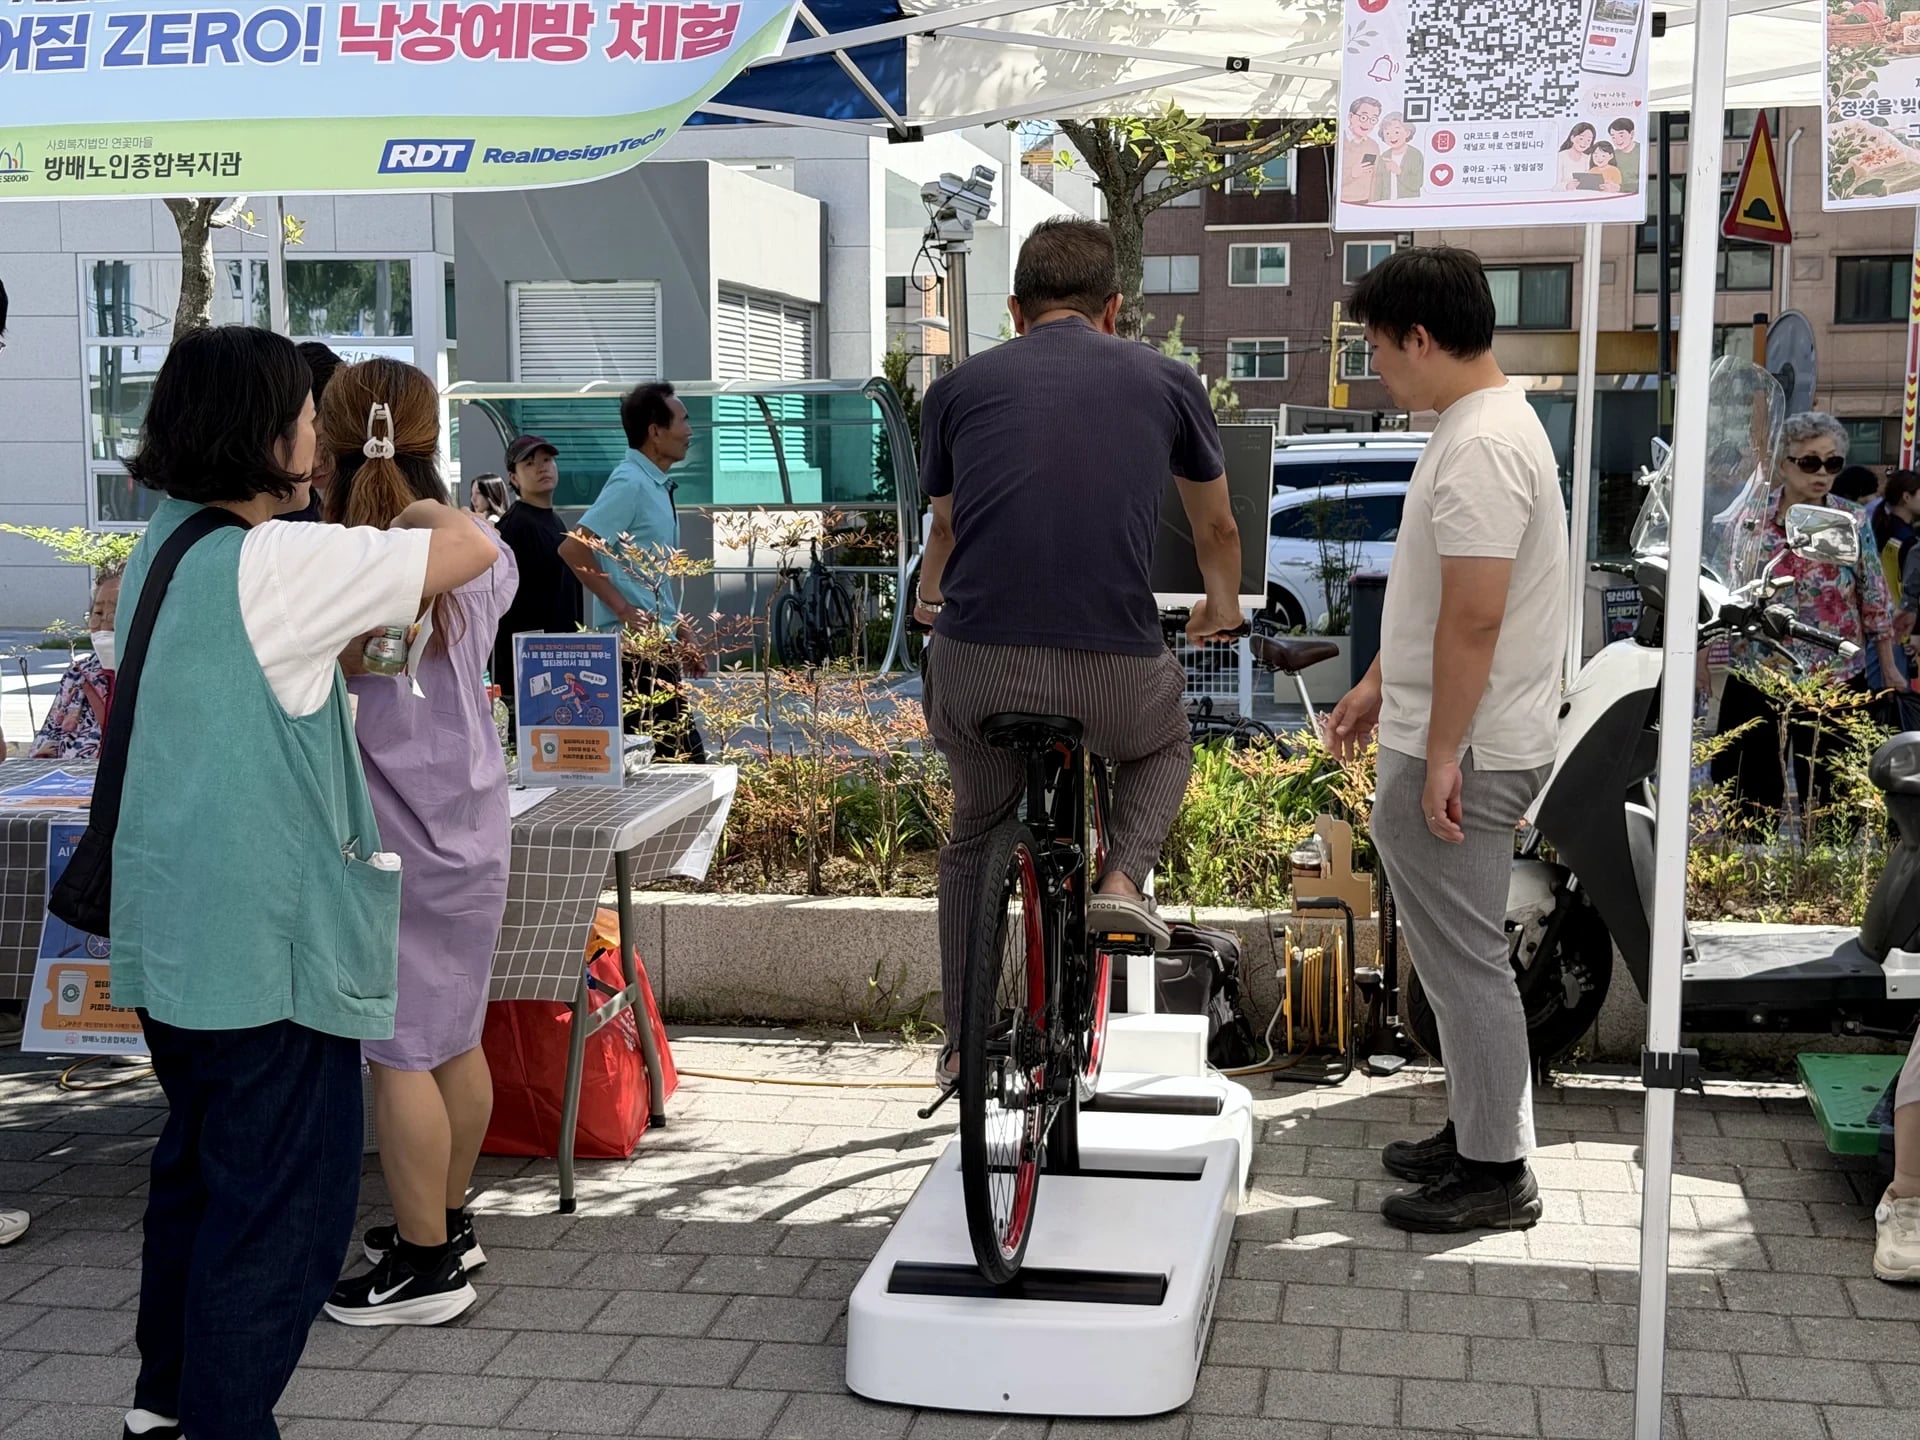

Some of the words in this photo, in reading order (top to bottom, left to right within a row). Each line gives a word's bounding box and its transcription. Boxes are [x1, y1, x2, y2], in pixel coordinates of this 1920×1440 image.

[103, 6, 323, 67] ZERO!
[338, 2, 596, 63] 낙상예방
[605, 1, 743, 62] 체험
[1463, 131, 1500, 141] QR코드를
[1502, 130, 1534, 139] 스캔하면
[46, 138, 109, 151] 사회복지법인
[111, 136, 154, 149] 연꽃마을
[387, 144, 466, 168] RDT
[483, 127, 667, 164] RealDesignTech
[1463, 142, 1486, 152] 채널로
[1488, 142, 1504, 151] 바로
[1505, 140, 1544, 150] 연결됩니다
[44, 152, 243, 181] 방배노인종합복지관
[1462, 164, 1485, 174] 좋아요
[1491, 163, 1506, 172] 구독
[1513, 162, 1544, 172] 알림설정
[1462, 175, 1508, 185] 부탁드립니다
[1606, 590, 1636, 602] 당신이
[57, 846, 70, 857] AI
